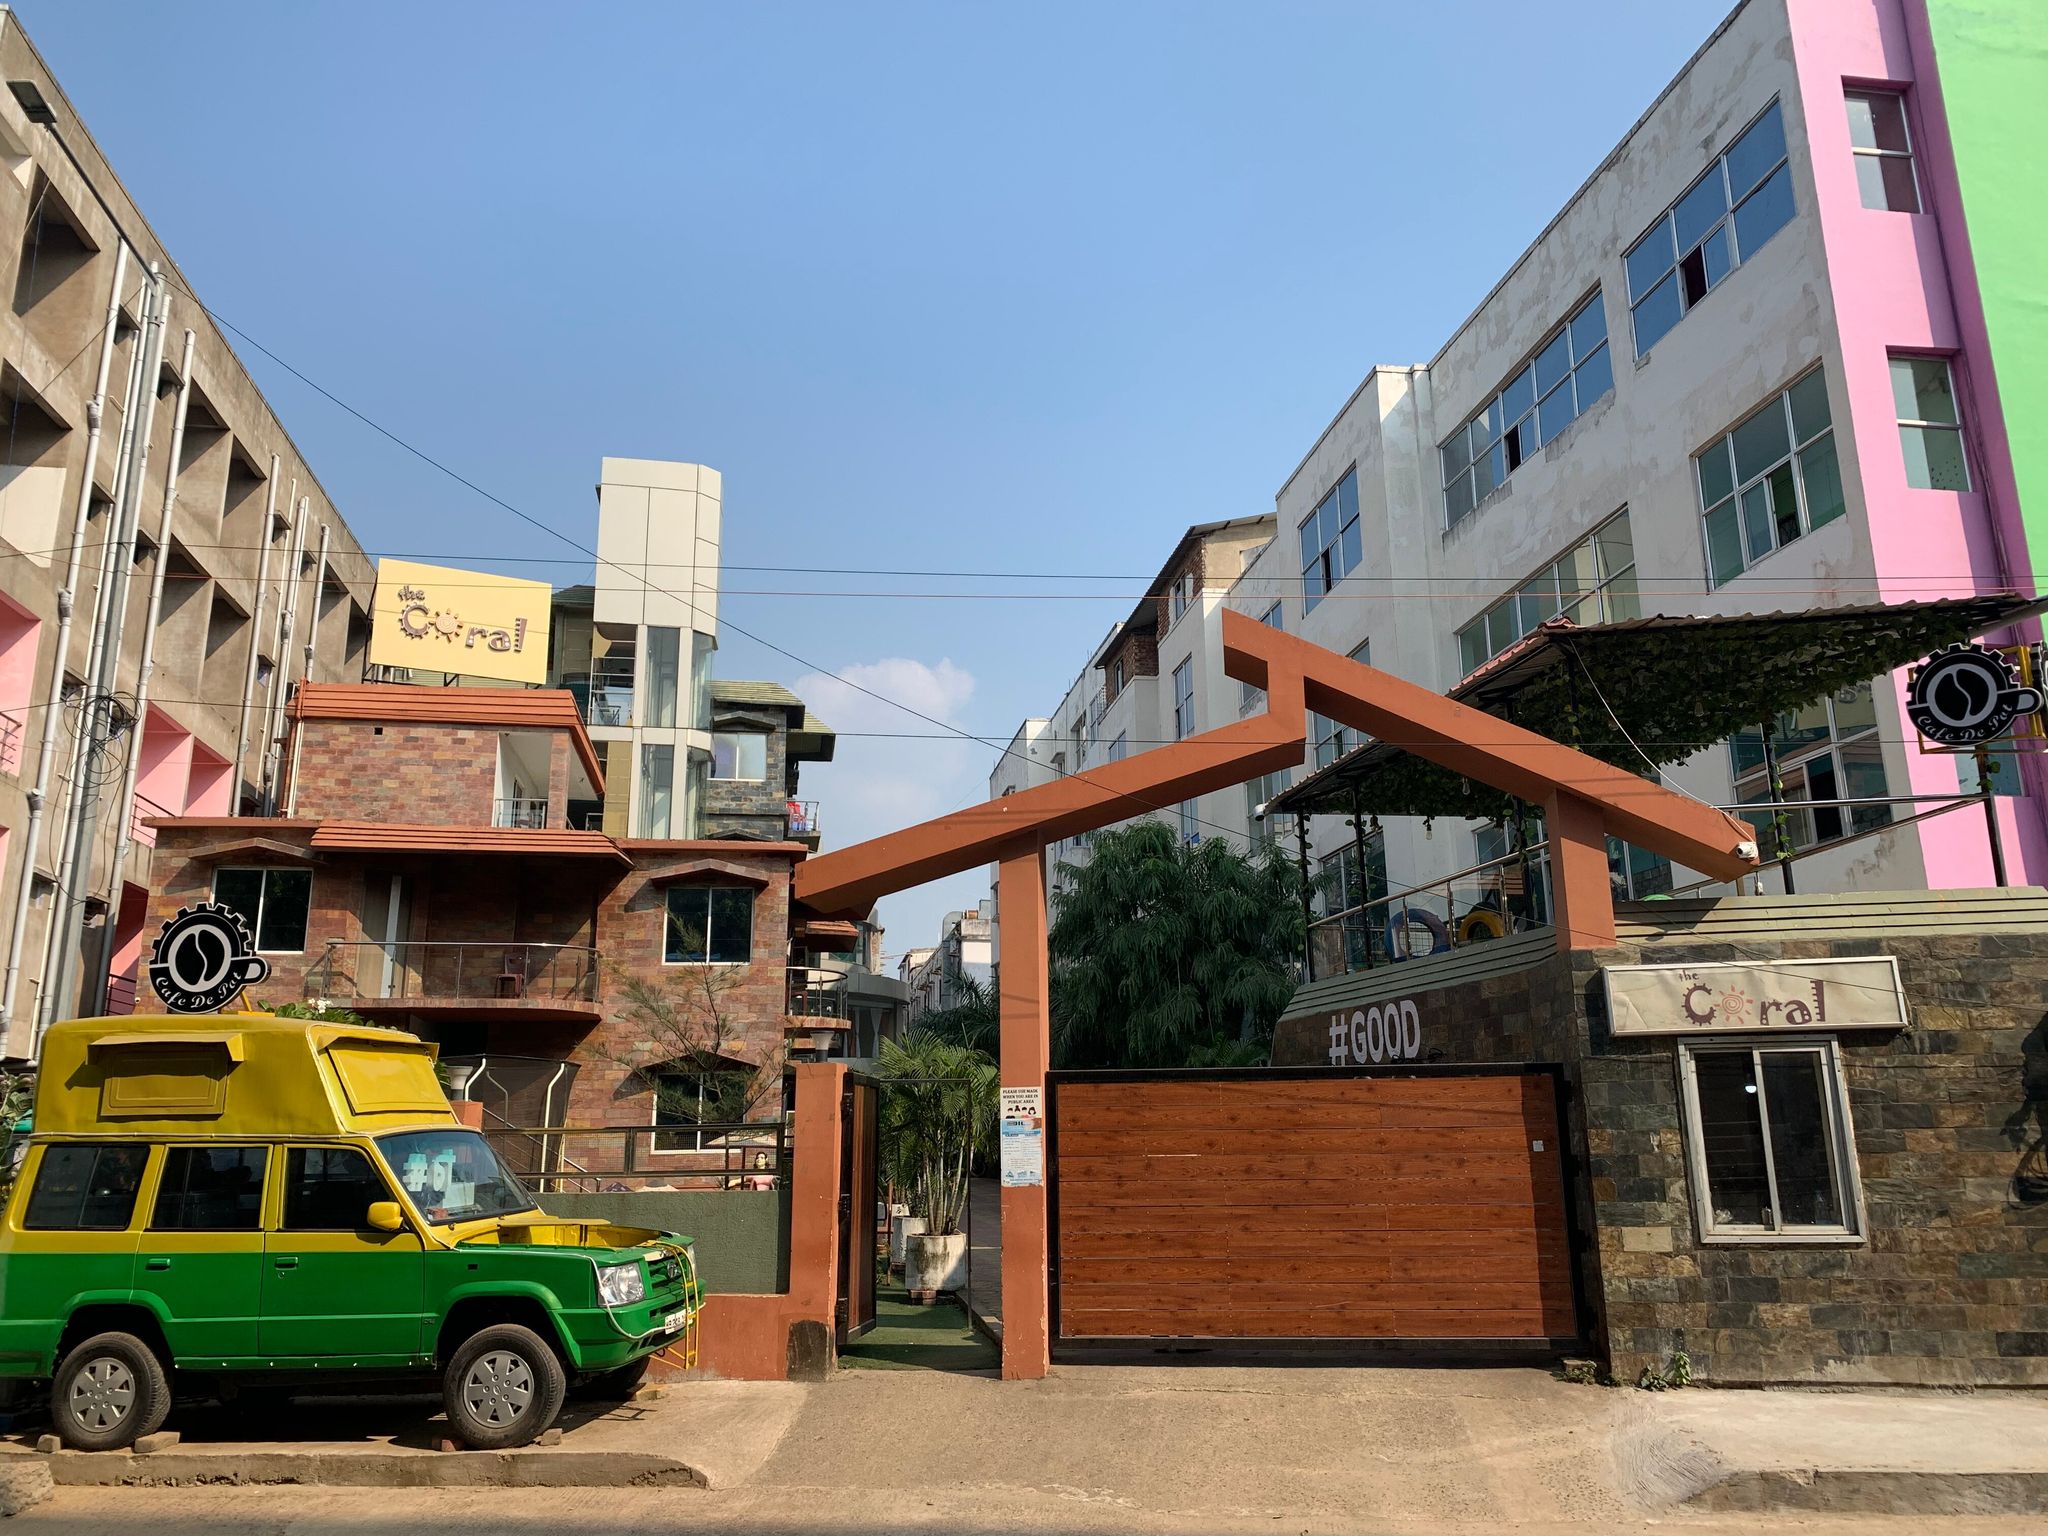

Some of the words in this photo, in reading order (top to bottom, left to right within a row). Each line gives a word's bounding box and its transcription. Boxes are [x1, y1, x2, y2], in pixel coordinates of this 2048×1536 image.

[398, 586, 426, 601] the
[398, 602, 528, 653] Coral
[1917, 715, 1954, 740] Cafe
[1960, 728, 1985, 741] De
[1988, 703, 2012, 731] Pot
[156, 977, 186, 1006] Cafe
[190, 995, 215, 1008] De
[218, 972, 242, 999] Pot
[1678, 969, 1700, 982] the
[1681, 979, 1826, 1026] Coral
[1329, 1000, 1420, 1067] #GOOD
